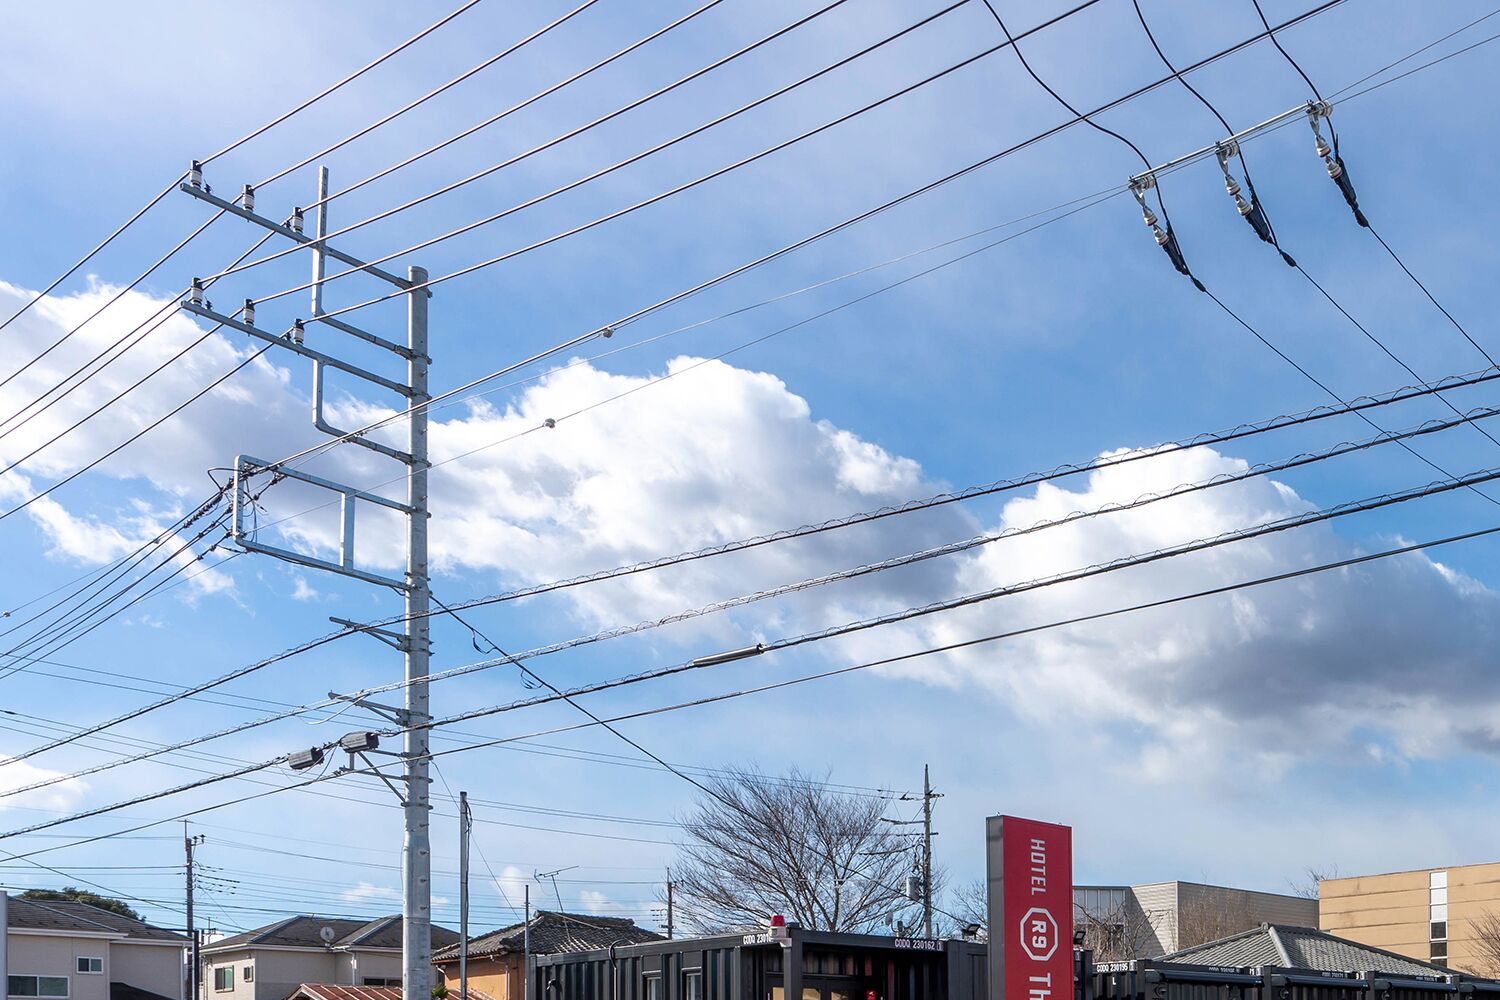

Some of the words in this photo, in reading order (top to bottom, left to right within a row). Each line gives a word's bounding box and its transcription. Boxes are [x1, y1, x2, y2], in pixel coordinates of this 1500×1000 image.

[1031, 838, 1046, 896] HOTEL
[912, 940, 935, 950] 230162
[1031, 920, 1047, 949] R9
